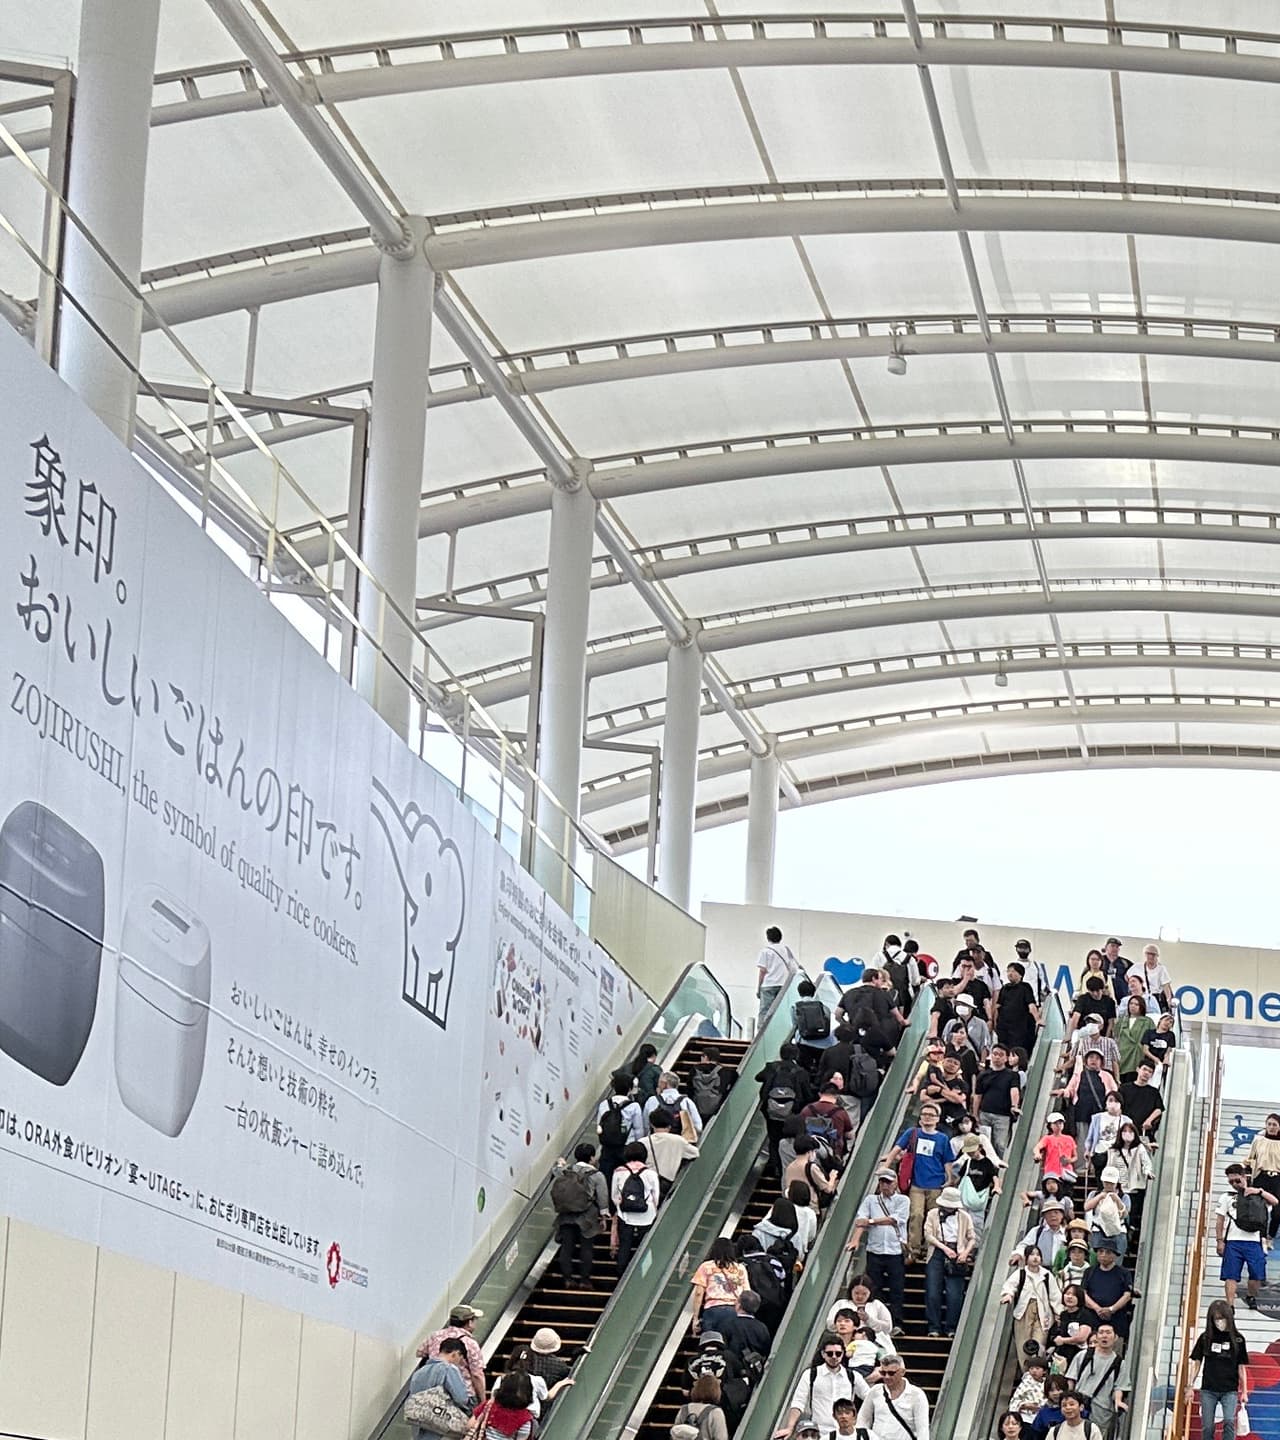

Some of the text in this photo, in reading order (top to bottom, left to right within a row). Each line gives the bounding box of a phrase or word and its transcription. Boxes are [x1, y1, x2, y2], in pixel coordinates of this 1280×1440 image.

[24, 432, 127, 605] 象印。
[10, 671, 359, 966] ZOJIRUSHI, the symbol of quality rice cookers.
[16, 553, 363, 911] おいしいごはんの印です。
